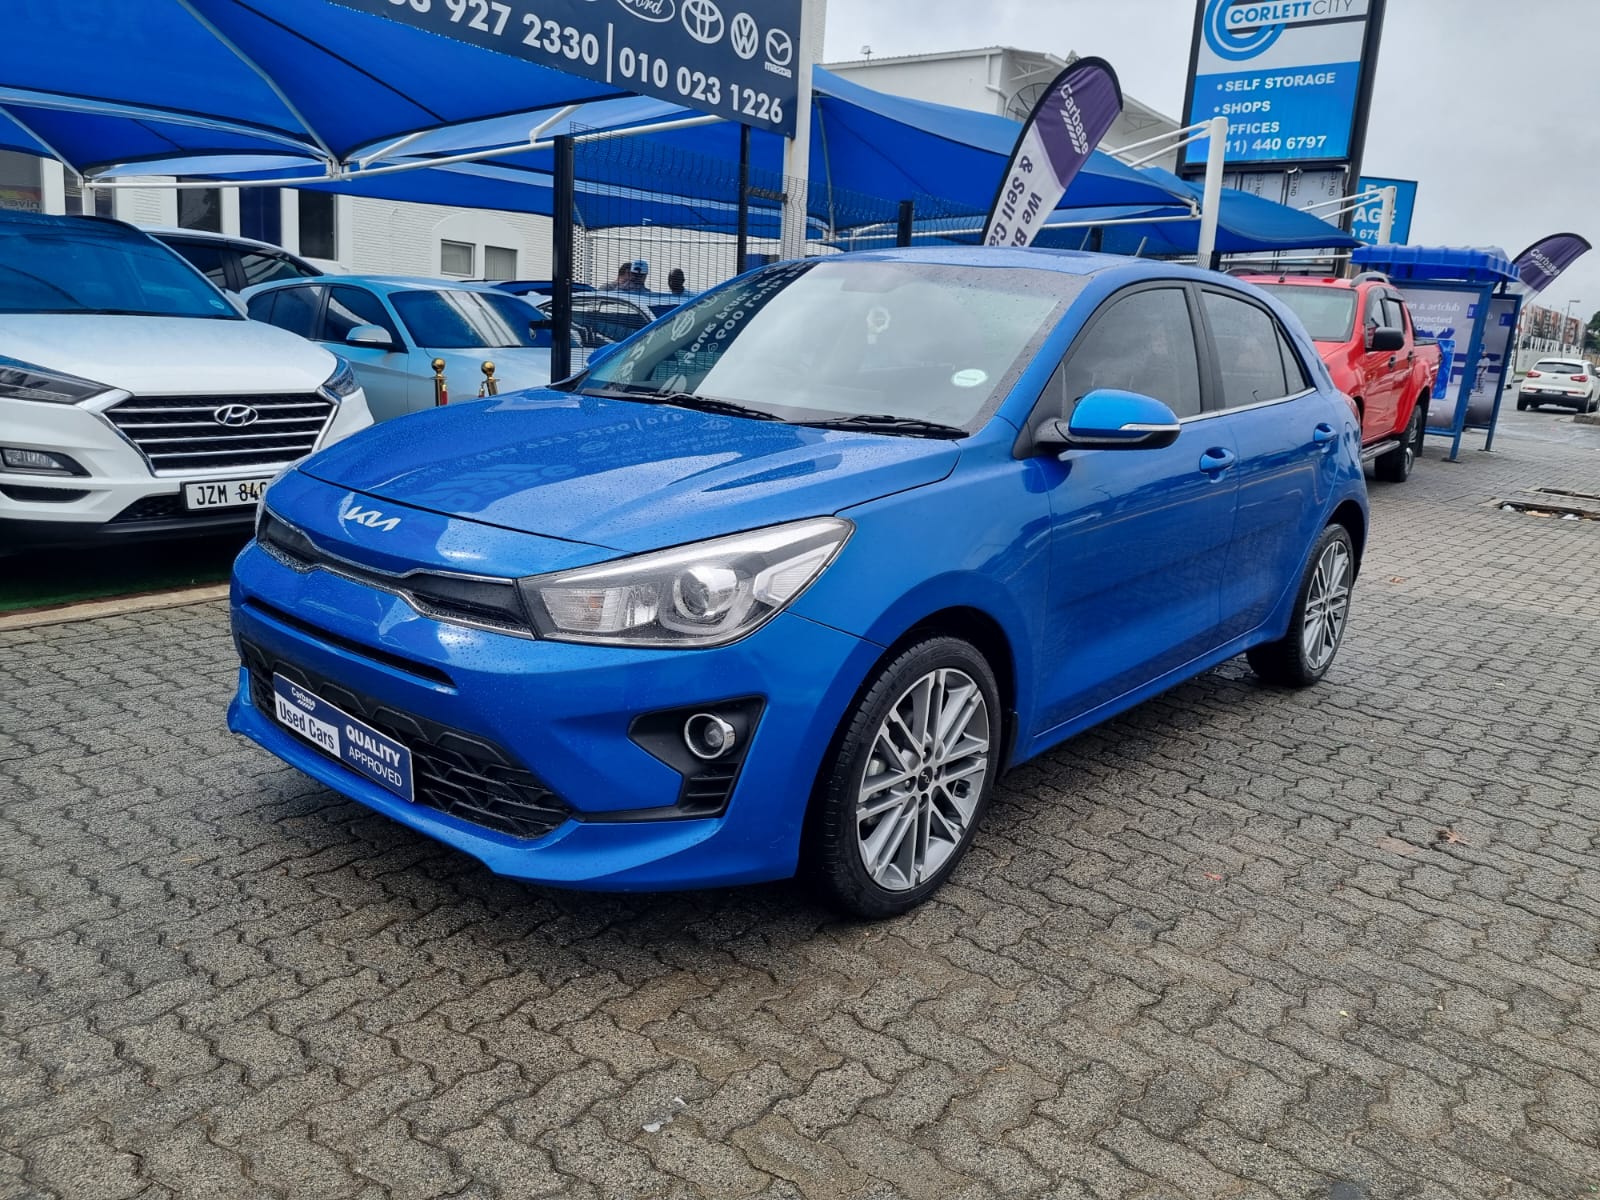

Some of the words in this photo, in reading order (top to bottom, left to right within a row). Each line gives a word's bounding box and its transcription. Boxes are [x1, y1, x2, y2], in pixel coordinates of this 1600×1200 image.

[445, 0, 512, 36] 927
[522, 13, 600, 66] 2330
[619, 47, 669, 88] 010
[676, 66, 721, 105] 023
[730, 83, 783, 124] 1226
[1224, 79, 1260, 92] SELF
[1265, 72, 1336, 89] STORAGE
[1060, 83, 1088, 156] Carbase
[1222, 100, 1271, 114] SHOPS
[1226, 121, 1280, 135] FFICES
[1252, 138, 1282, 151] 440
[1286, 136, 1327, 150] 6797
[1019, 155, 1033, 174] &
[1002, 176, 1025, 222] Sell
[1023, 192, 1042, 225] We
[988, 222, 1007, 247] Ca
[1011, 227, 1028, 247] B
[196, 484, 228, 506] JZM
[279, 700, 306, 732] Used
[309, 718, 335, 750] Cars
[346, 724, 401, 768] QUALITY
[349, 745, 403, 788] APPROVED
